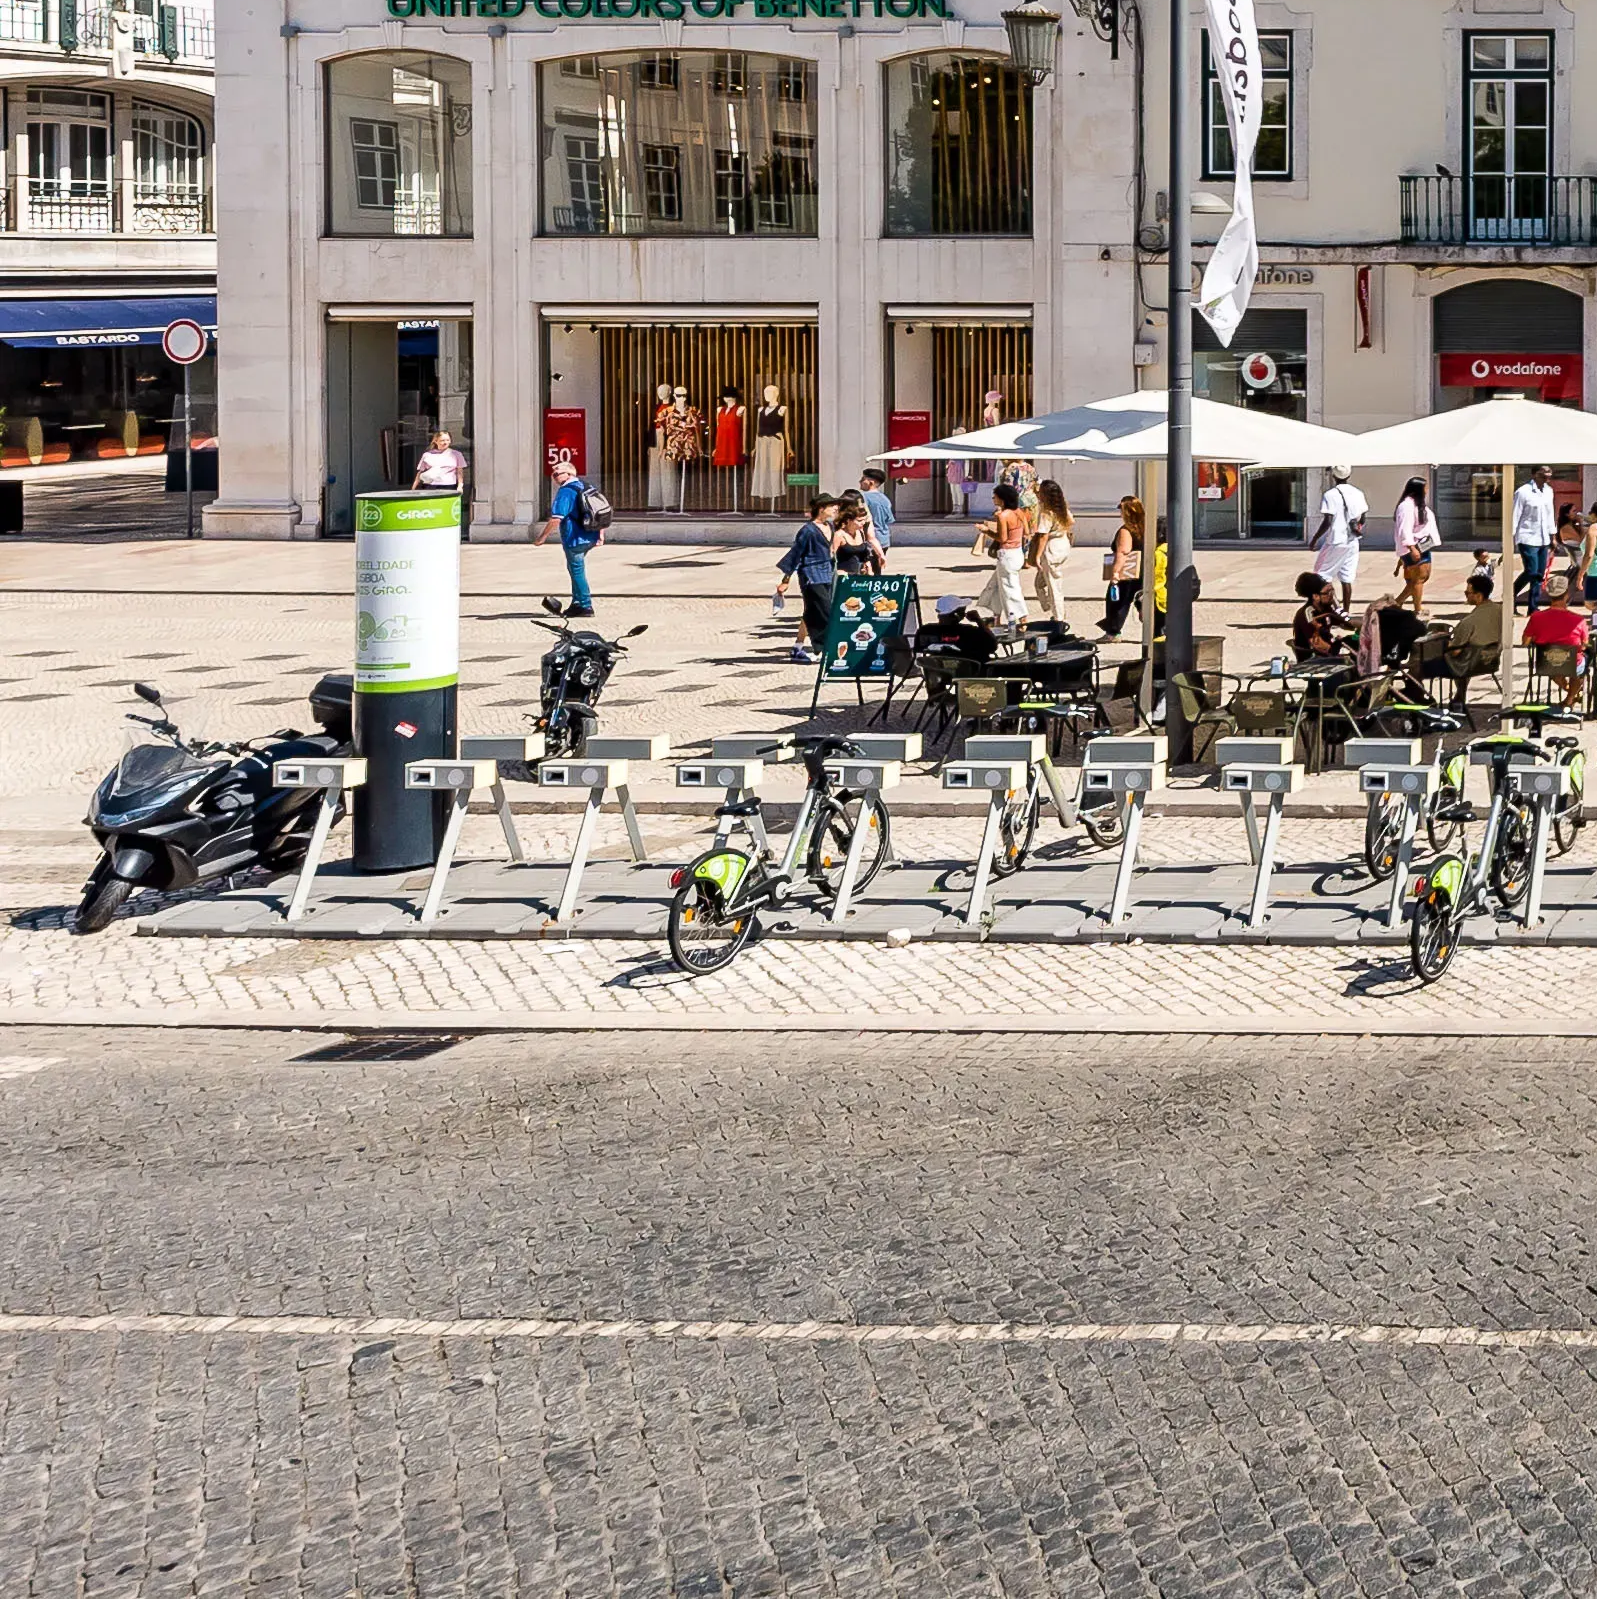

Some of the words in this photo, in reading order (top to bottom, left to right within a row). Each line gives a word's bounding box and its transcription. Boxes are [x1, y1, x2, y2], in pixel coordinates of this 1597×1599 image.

[56, 334, 140, 346] BASTARDO
[1493, 361, 1562, 375] vodafone
[867, 580, 900, 592] 1840
